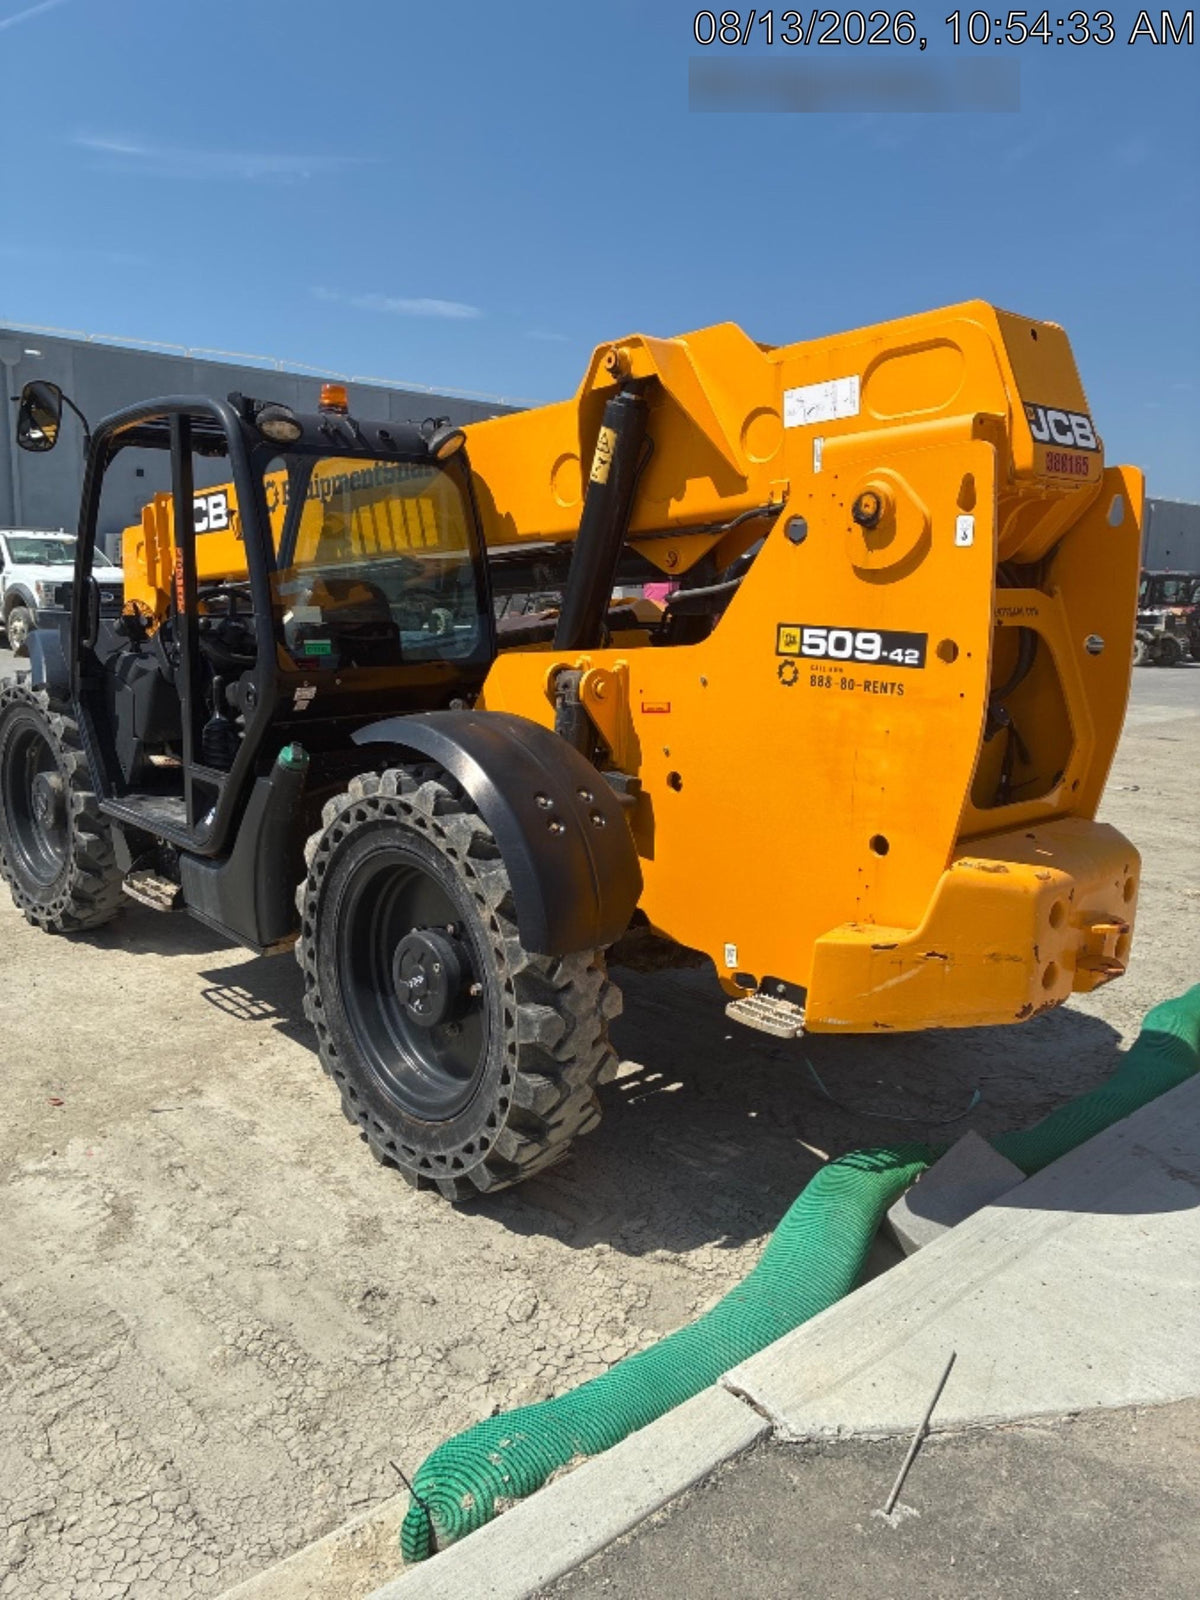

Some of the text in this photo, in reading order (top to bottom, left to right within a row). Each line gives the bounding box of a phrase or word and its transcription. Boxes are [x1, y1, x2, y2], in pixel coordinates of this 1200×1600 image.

[1030, 407, 1097, 449] JCB
[193, 492, 228, 533] CB
[801, 627, 921, 664] 509-42
